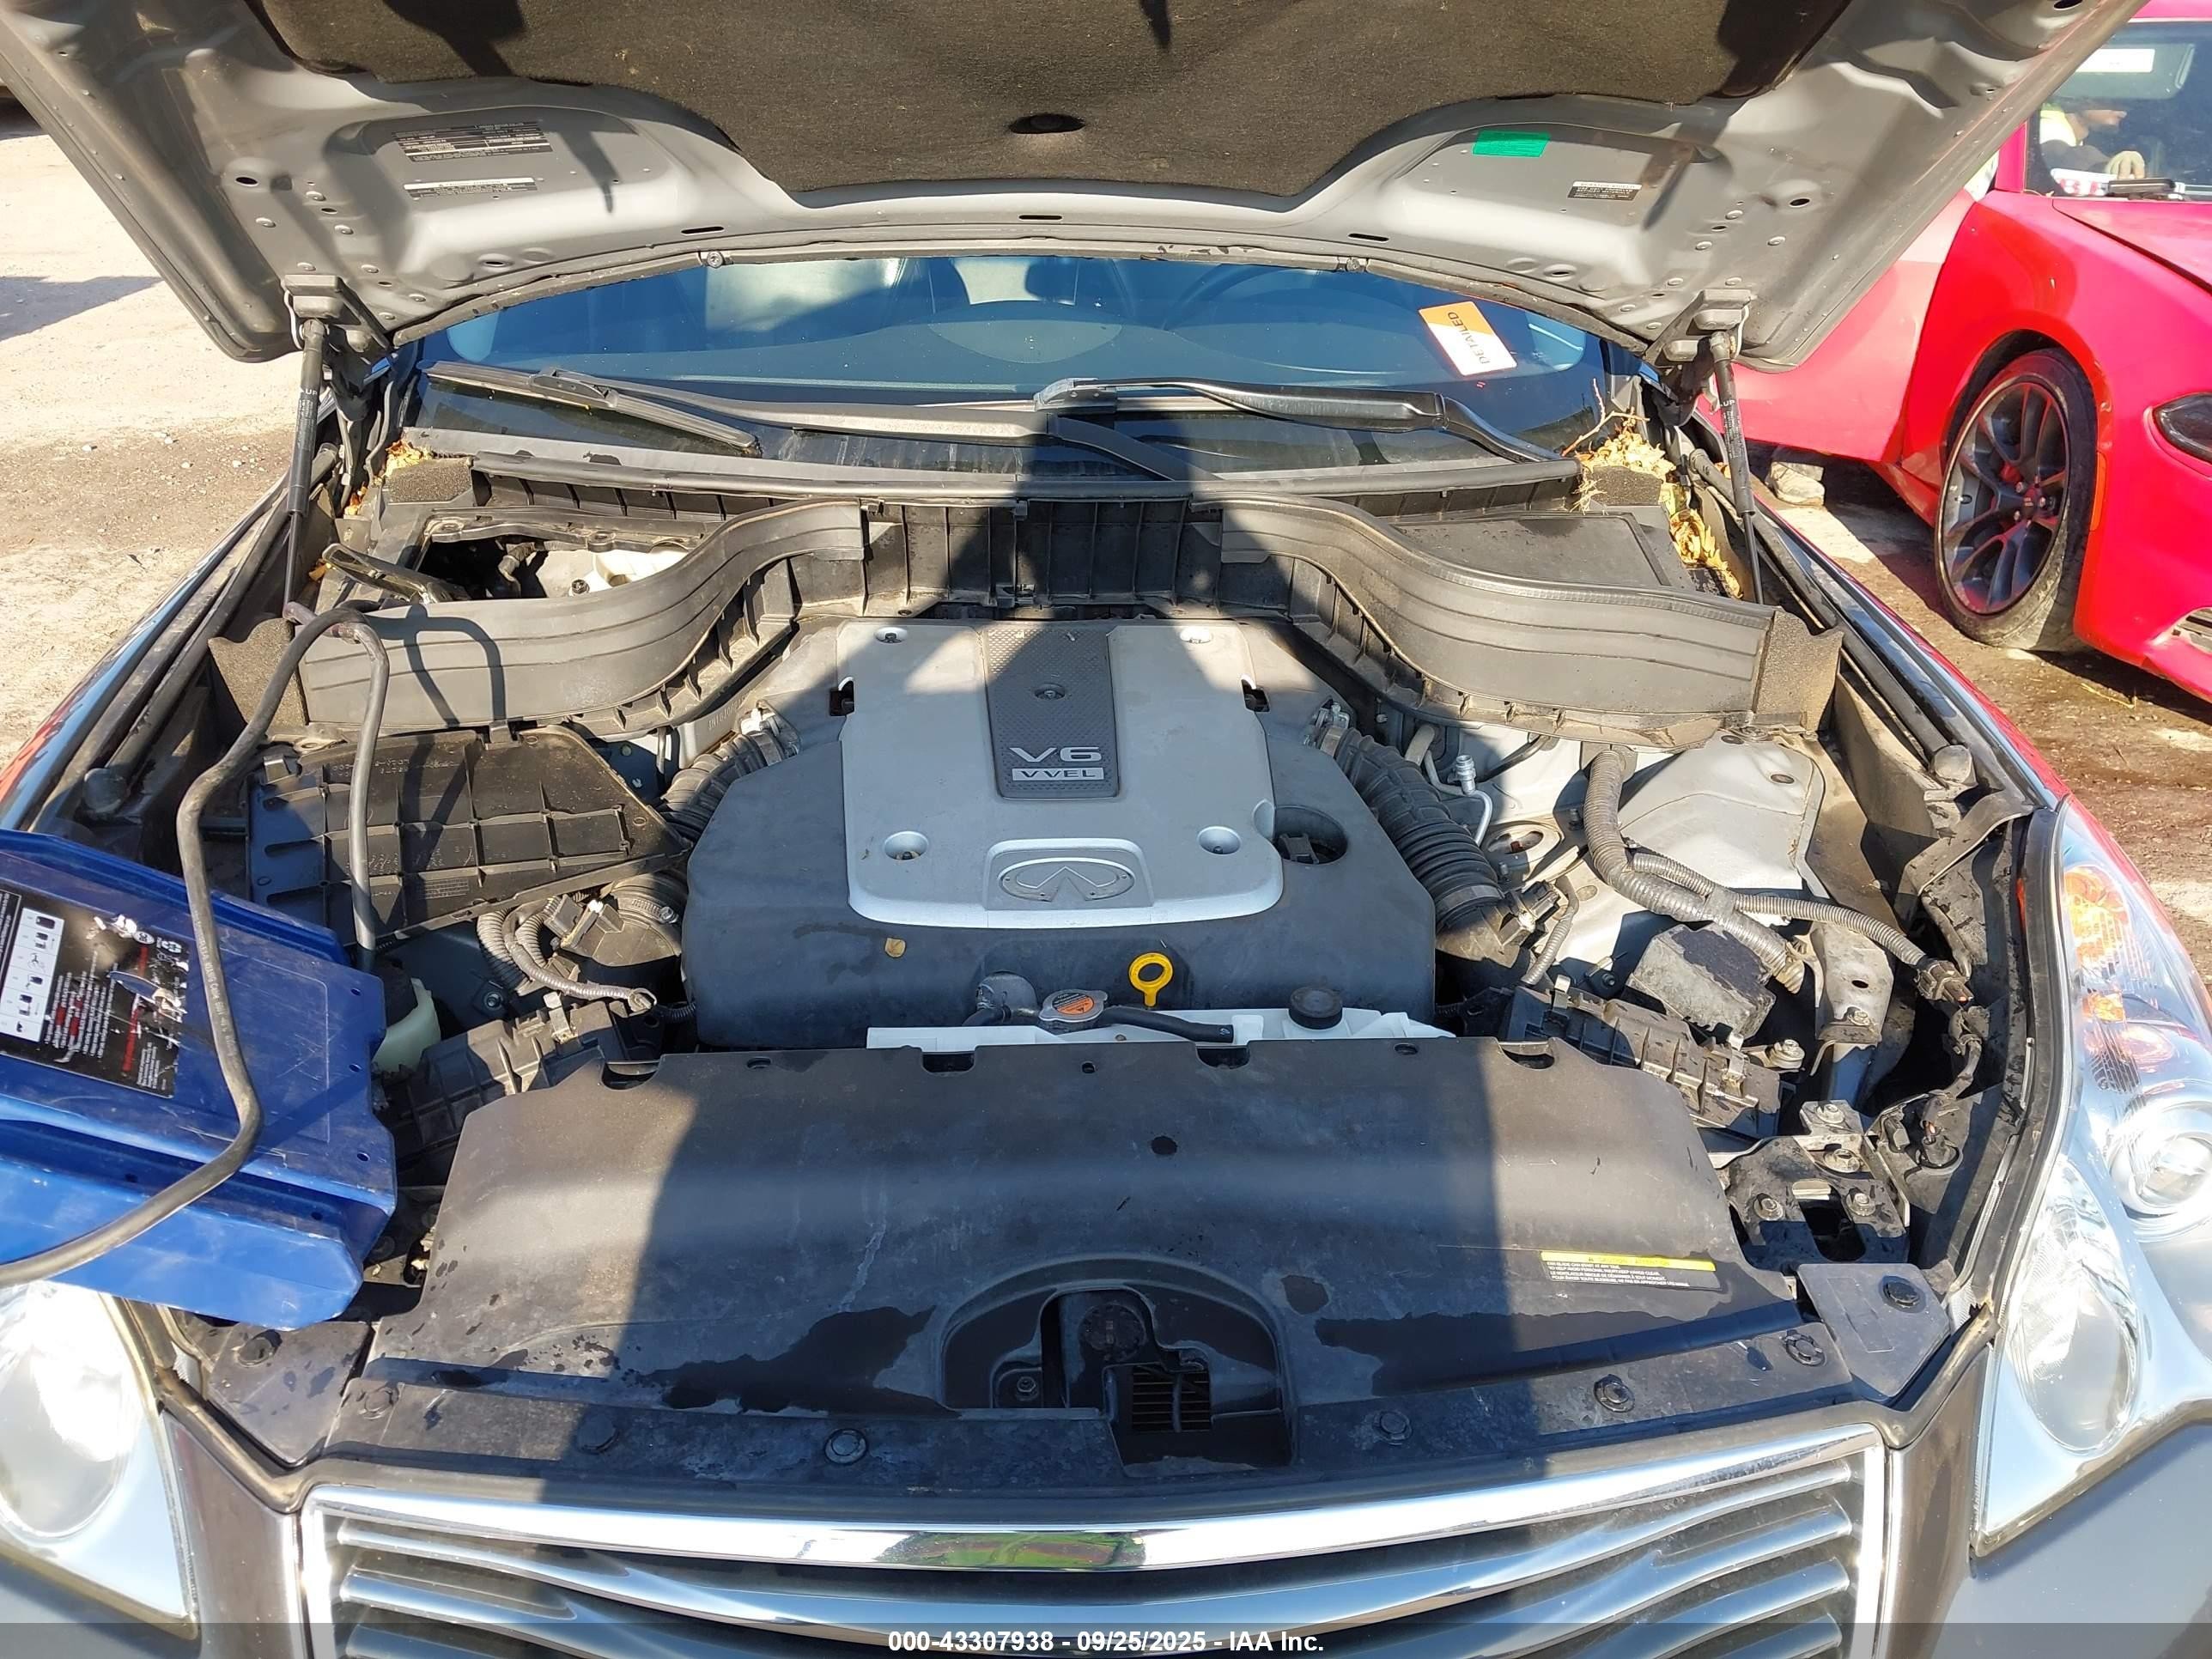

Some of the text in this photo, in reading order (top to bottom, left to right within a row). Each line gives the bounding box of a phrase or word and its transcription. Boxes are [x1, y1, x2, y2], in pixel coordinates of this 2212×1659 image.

[1448, 311, 1492, 364] DETAILED
[1723, 398, 1735, 407] UP
[1009, 746, 1103, 763] V6
[1020, 769, 1096, 778] VVEL
